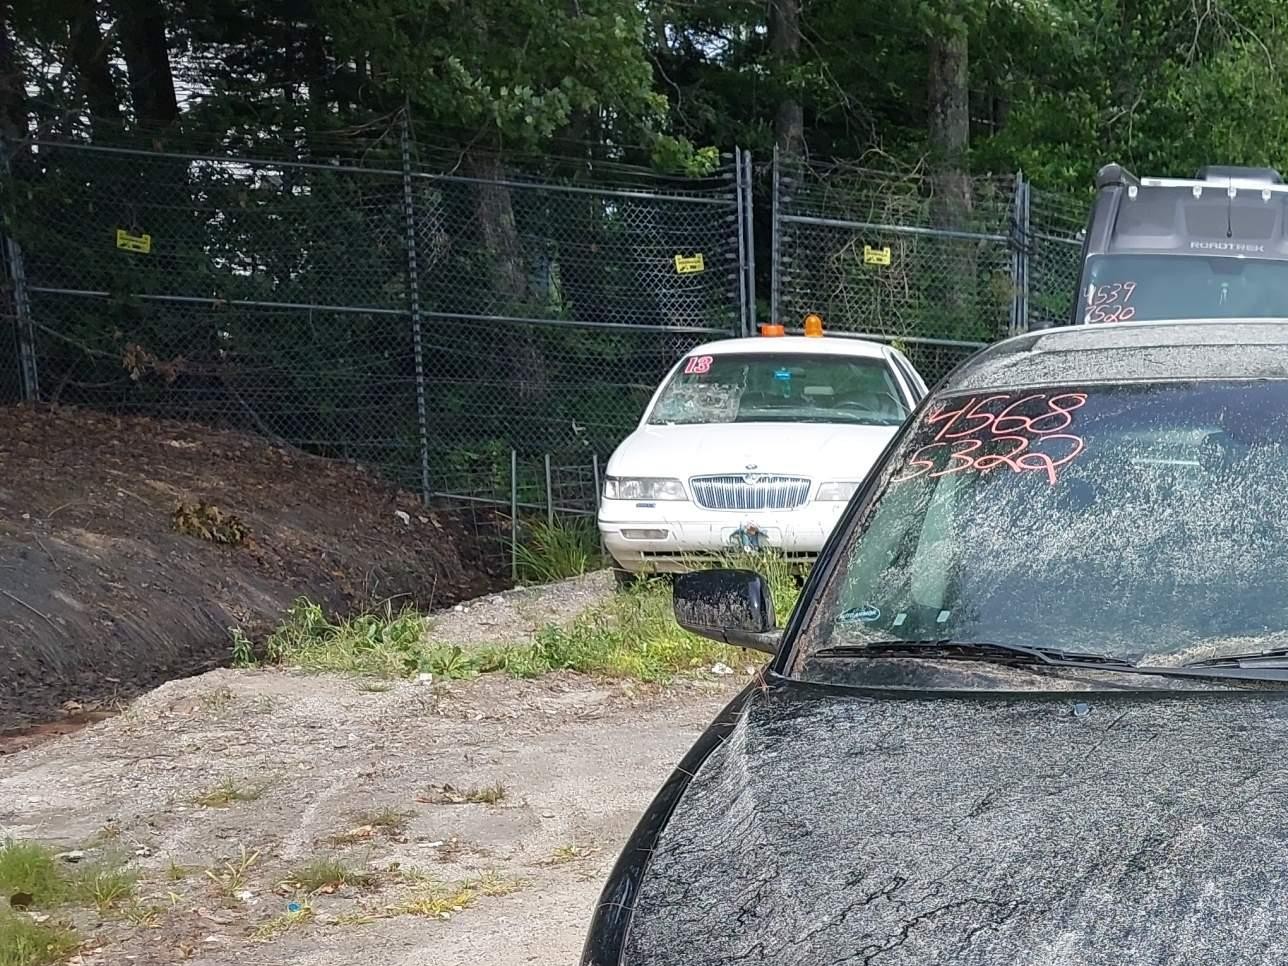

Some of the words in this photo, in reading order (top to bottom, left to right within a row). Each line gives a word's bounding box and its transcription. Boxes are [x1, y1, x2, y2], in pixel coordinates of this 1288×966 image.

[684, 356, 713, 374] 13
[928, 393, 1088, 441] 4568
[890, 434, 1084, 484] 5322
